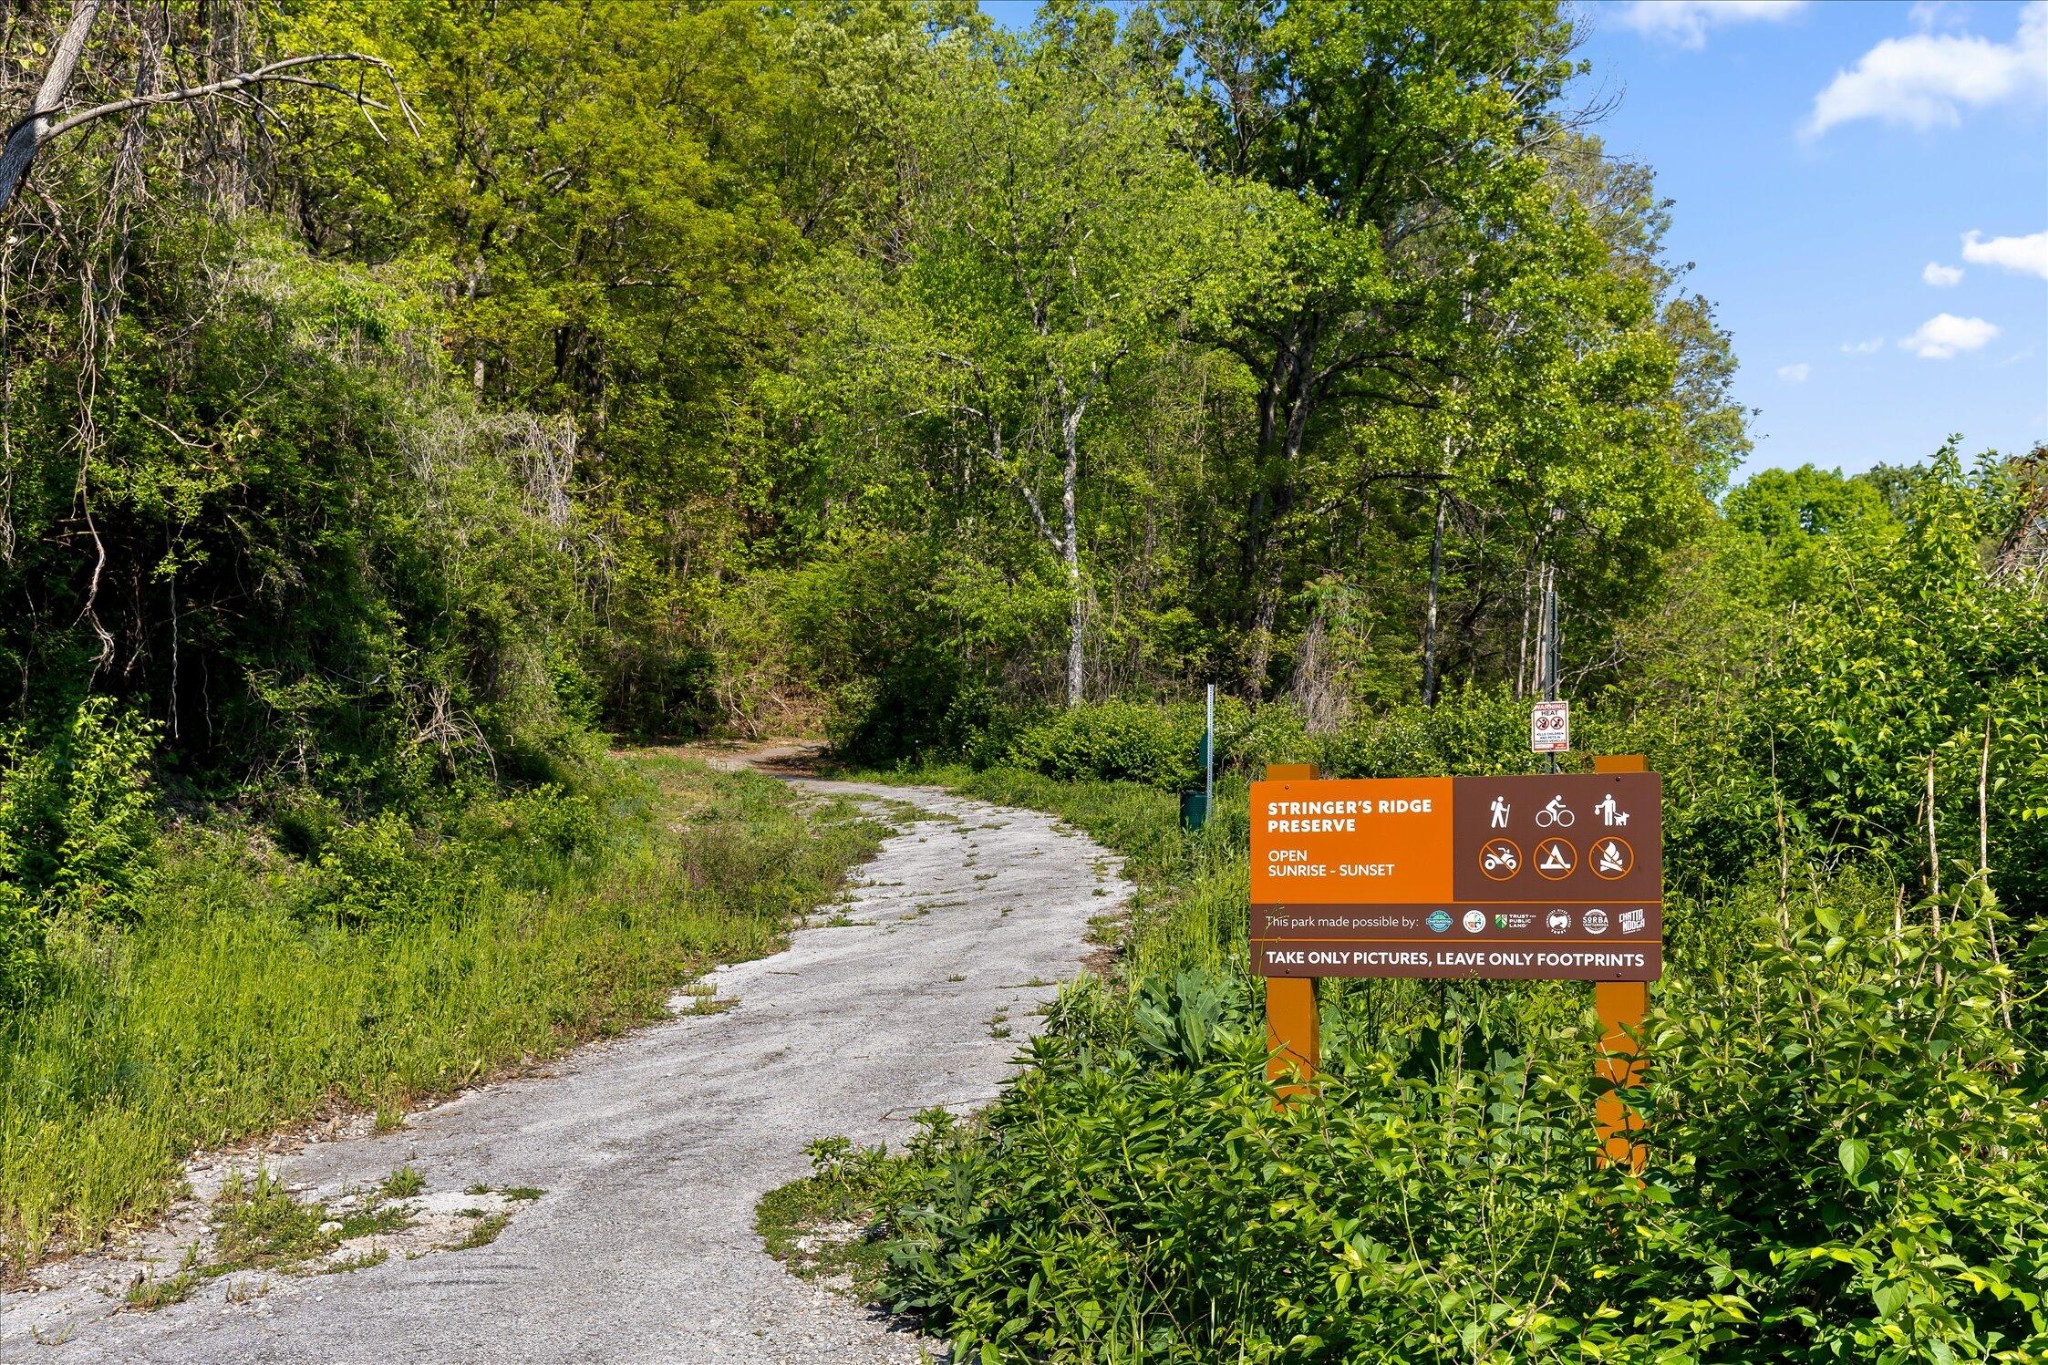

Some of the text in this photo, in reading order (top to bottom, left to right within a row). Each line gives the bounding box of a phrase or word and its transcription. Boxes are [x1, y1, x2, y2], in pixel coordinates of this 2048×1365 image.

[1268, 798, 1432, 815] STRINGER'S RIDGE
[1268, 818, 1356, 832] PRESERVE
[1269, 850, 1307, 862] OPEN
[1268, 864, 1326, 877] SUNRISE
[1339, 864, 1395, 876] SUNSET
[1266, 915, 1419, 930] This park made possible by:
[1267, 952, 1644, 967] TAKE ONLY PICTURES, LEAVE ONLY FOOTPRINTS
